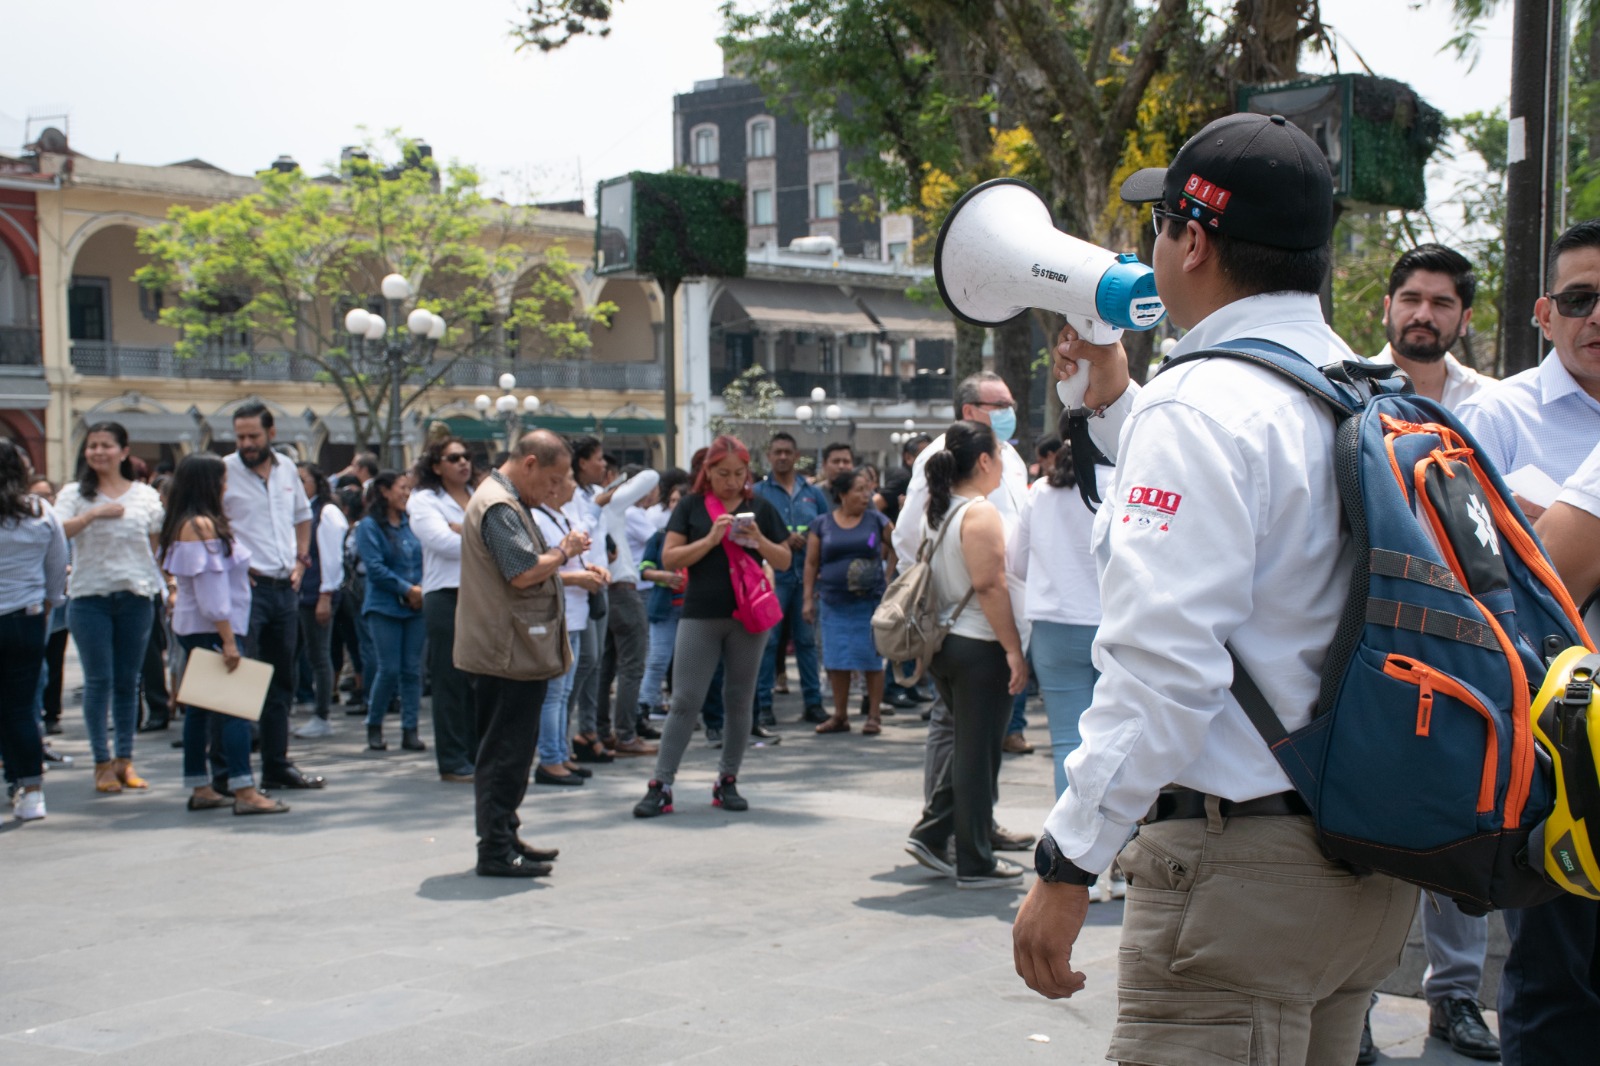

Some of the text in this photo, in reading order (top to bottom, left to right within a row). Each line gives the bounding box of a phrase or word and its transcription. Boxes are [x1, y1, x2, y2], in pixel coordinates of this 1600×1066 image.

[1188, 177, 1225, 205] 911
[1040, 268, 1069, 284] STEREN
[1131, 488, 1177, 509] 911
[1560, 850, 1575, 871] MSA
